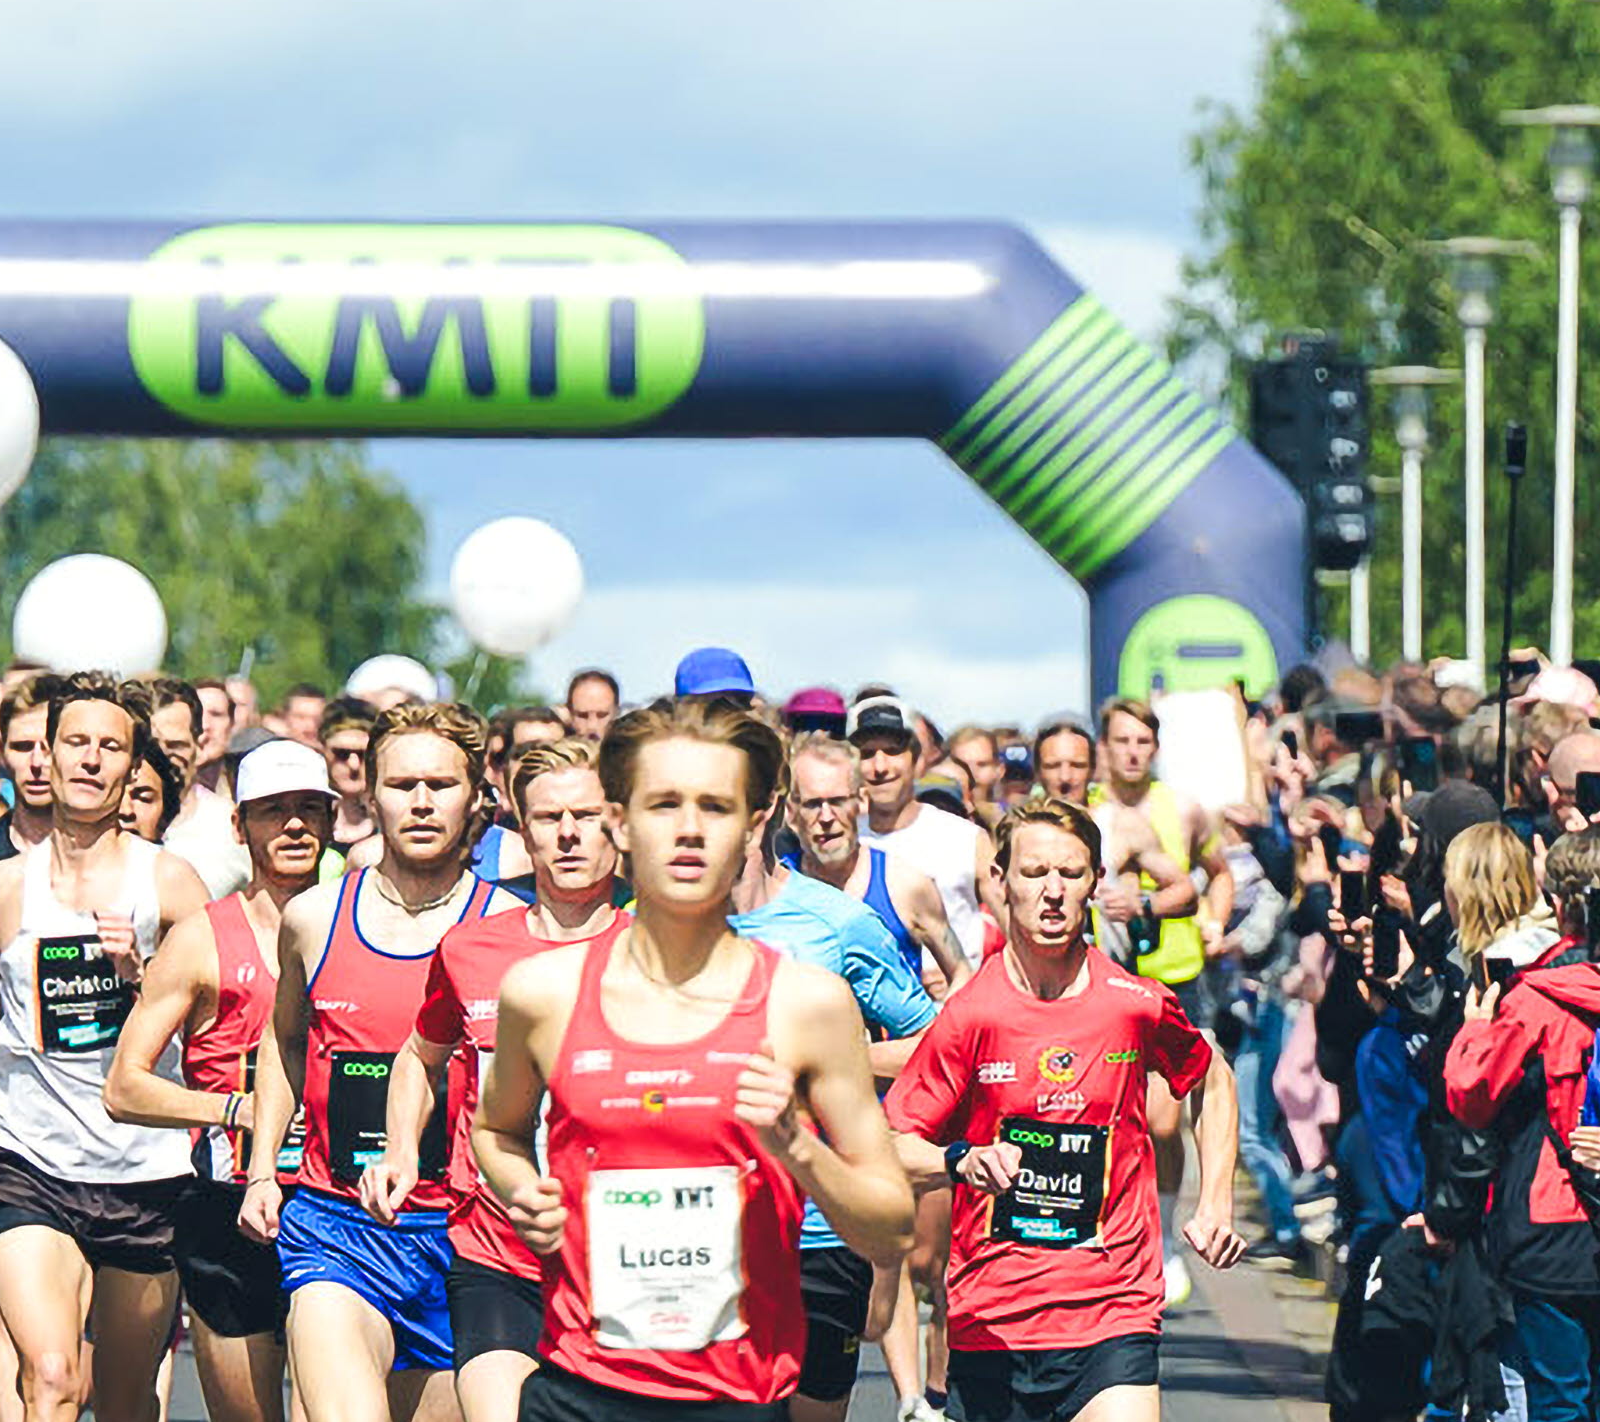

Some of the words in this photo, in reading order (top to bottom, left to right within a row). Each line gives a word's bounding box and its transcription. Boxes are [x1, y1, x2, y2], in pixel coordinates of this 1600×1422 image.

[196, 256, 637, 398] KMTI
[343, 1062, 389, 1078] coop
[1009, 1128, 1055, 1148] coop
[1018, 1168, 1082, 1194] David
[619, 1244, 712, 1269] Lucas
